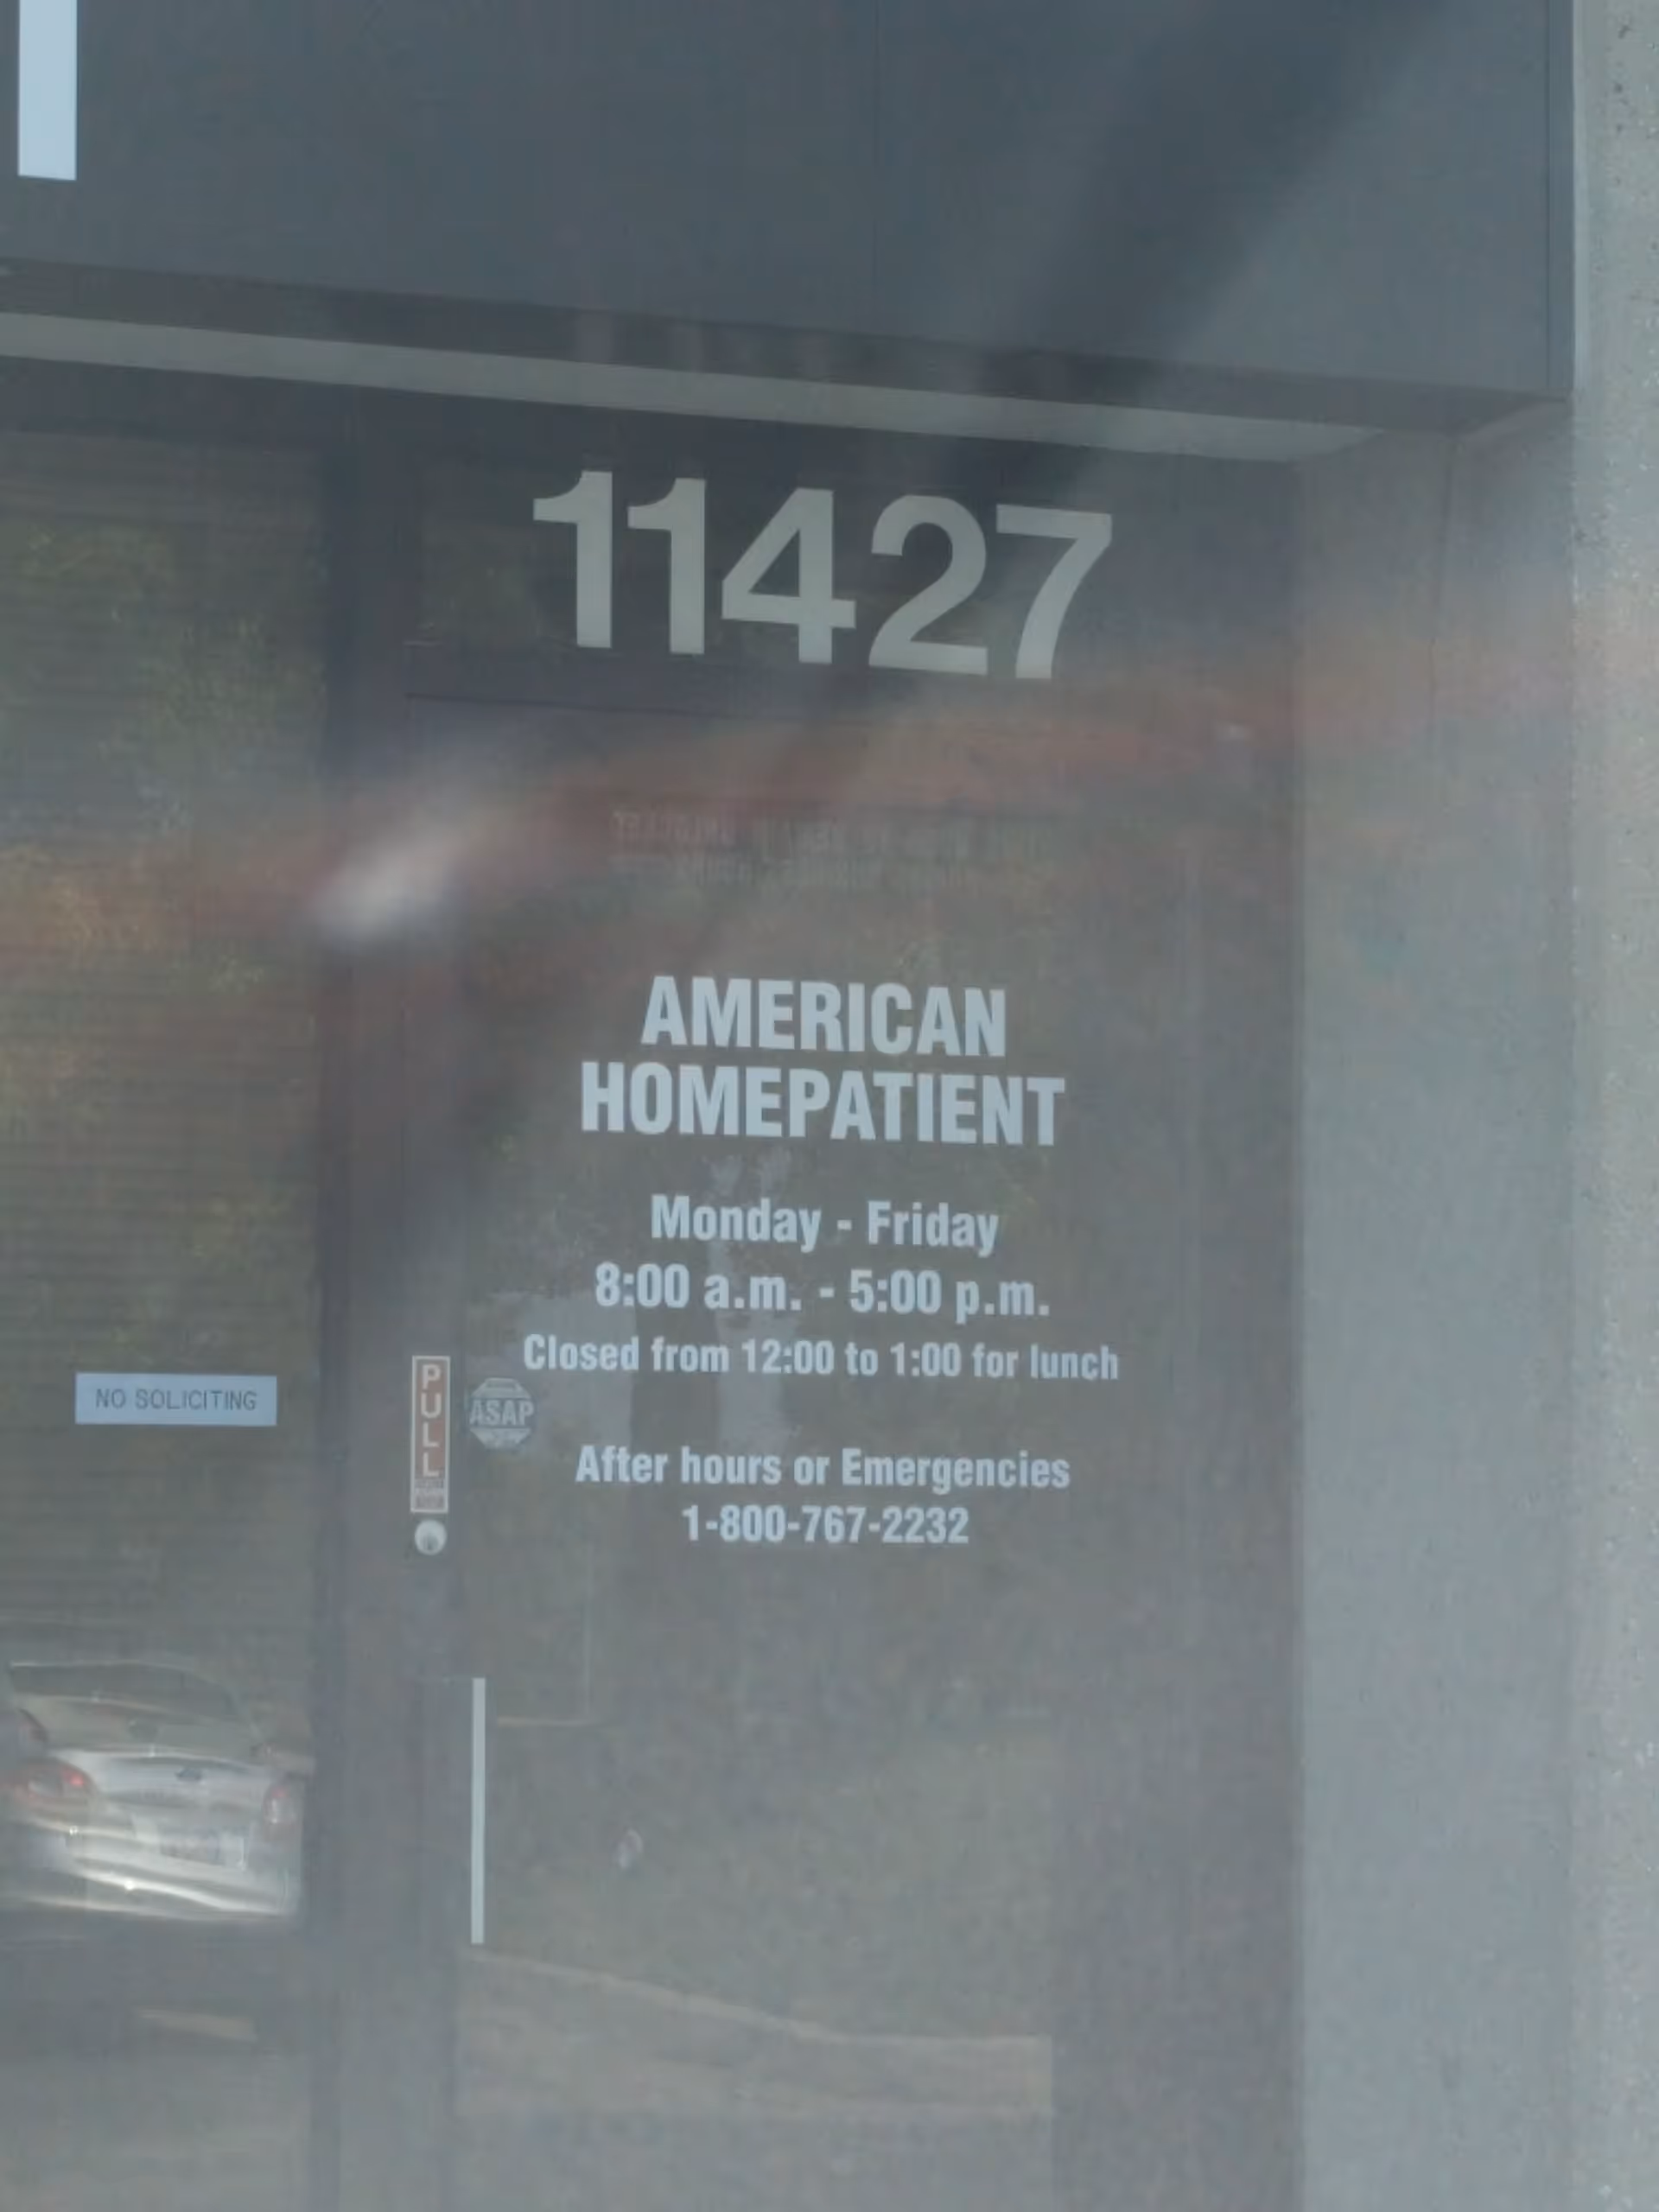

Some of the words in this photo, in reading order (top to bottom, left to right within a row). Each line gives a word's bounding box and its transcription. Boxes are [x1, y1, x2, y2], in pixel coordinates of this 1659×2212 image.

[533, 470, 1113, 680] 11427
[641, 976, 1006, 1057] AMERICAN
[581, 1061, 1065, 1147] HOMEPATIENT
[651, 1194, 821, 1253] Monday
[837, 1219, 851, 1230] -
[868, 1200, 999, 1256] Friday
[594, 1262, 690, 1309] 8:00
[703, 1271, 802, 1311] a.m.
[819, 1289, 835, 1298] -
[849, 1269, 942, 1314] 5:00
[956, 1280, 1050, 1324] p.m.
[523, 1334, 639, 1372] Closed
[652, 1338, 729, 1372] from
[742, 1338, 834, 1375] 12:00
[845, 1344, 878, 1376] to
[891, 1343, 961, 1377] 1:00
[973, 1345, 1019, 1378] for
[1030, 1344, 1119, 1380] lunch
[96, 1389, 126, 1409] NO
[135, 1389, 257, 1411] SOLICITING
[420, 1363, 442, 1478] PULL
[469, 1399, 534, 1427] ASAP
[575, 1445, 669, 1484] After
[680, 1447, 781, 1485] hours
[793, 1454, 830, 1485] or
[841, 1448, 1071, 1495] Emergencies
[682, 1504, 969, 1544] 1-800-767-2232
